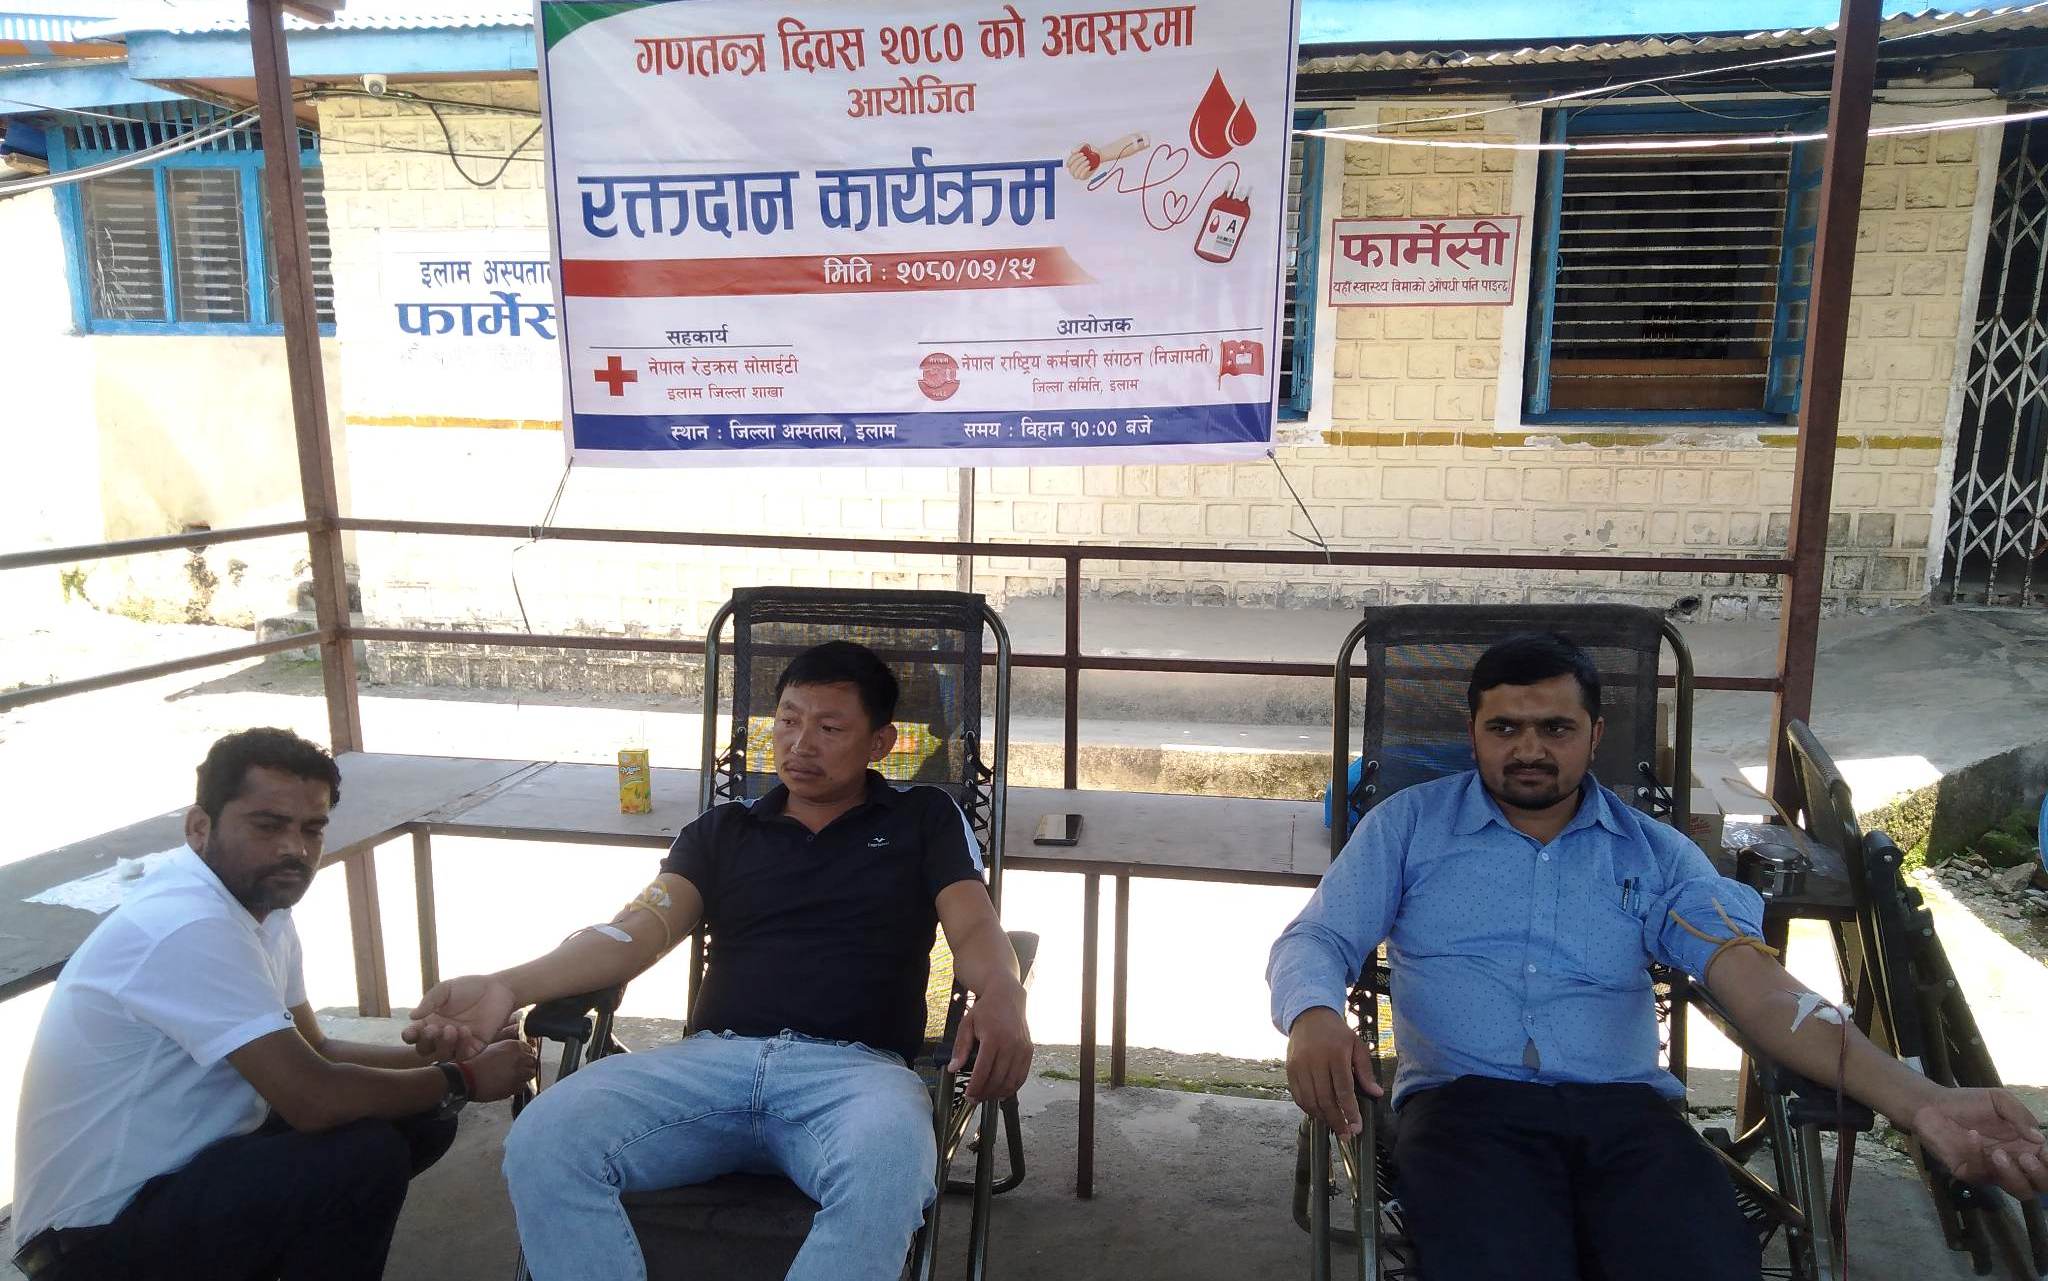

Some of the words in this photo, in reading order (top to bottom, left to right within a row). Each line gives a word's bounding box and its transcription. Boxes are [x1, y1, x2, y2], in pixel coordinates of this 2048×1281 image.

[634, 34, 766, 77] गणतन्त्र
[777, 16, 865, 73] दिवस
[879, 23, 964, 65] २०८०
[978, 4, 1026, 59] को
[1041, 5, 1196, 56] अवसरमा
[847, 74, 977, 118] आयोजित
[577, 171, 800, 238] रक्तदान
[815, 146, 1064, 231] कार्यक्रम
[1226, 219, 1237, 233] A
[1339, 220, 1511, 270] फार्मेसी
[419, 261, 472, 288] इलाम
[483, 260, 551, 287] अस्पता
[823, 256, 873, 285] मिति
[896, 257, 1036, 285] २०८०/०२/१५
[394, 291, 557, 340] फार्मेस
[1057, 314, 1134, 336] आयोजक
[666, 324, 729, 346] सहकार्य
[648, 356, 685, 376] नेपाल
[691, 356, 738, 376] रेडक्रस
[744, 354, 799, 377] सोसाईटी
[961, 353, 995, 371] नेपाल
[1047, 349, 1098, 368] कर्मचारी
[1103, 349, 1144, 367] संगठन
[667, 387, 703, 401] इलाम
[708, 384, 746, 399] जिल्ला
[752, 386, 785, 400] शाखा
[1032, 378, 1064, 393] जिल्ला
[1110, 379, 1140, 392] इलाम
[671, 424, 709, 441] स्थान
[729, 419, 776, 440] जिल्ला
[855, 423, 897, 441] इलाम
[964, 422, 1001, 438] समय
[1021, 416, 1065, 440] विहान
[1126, 415, 1154, 436] बजे
